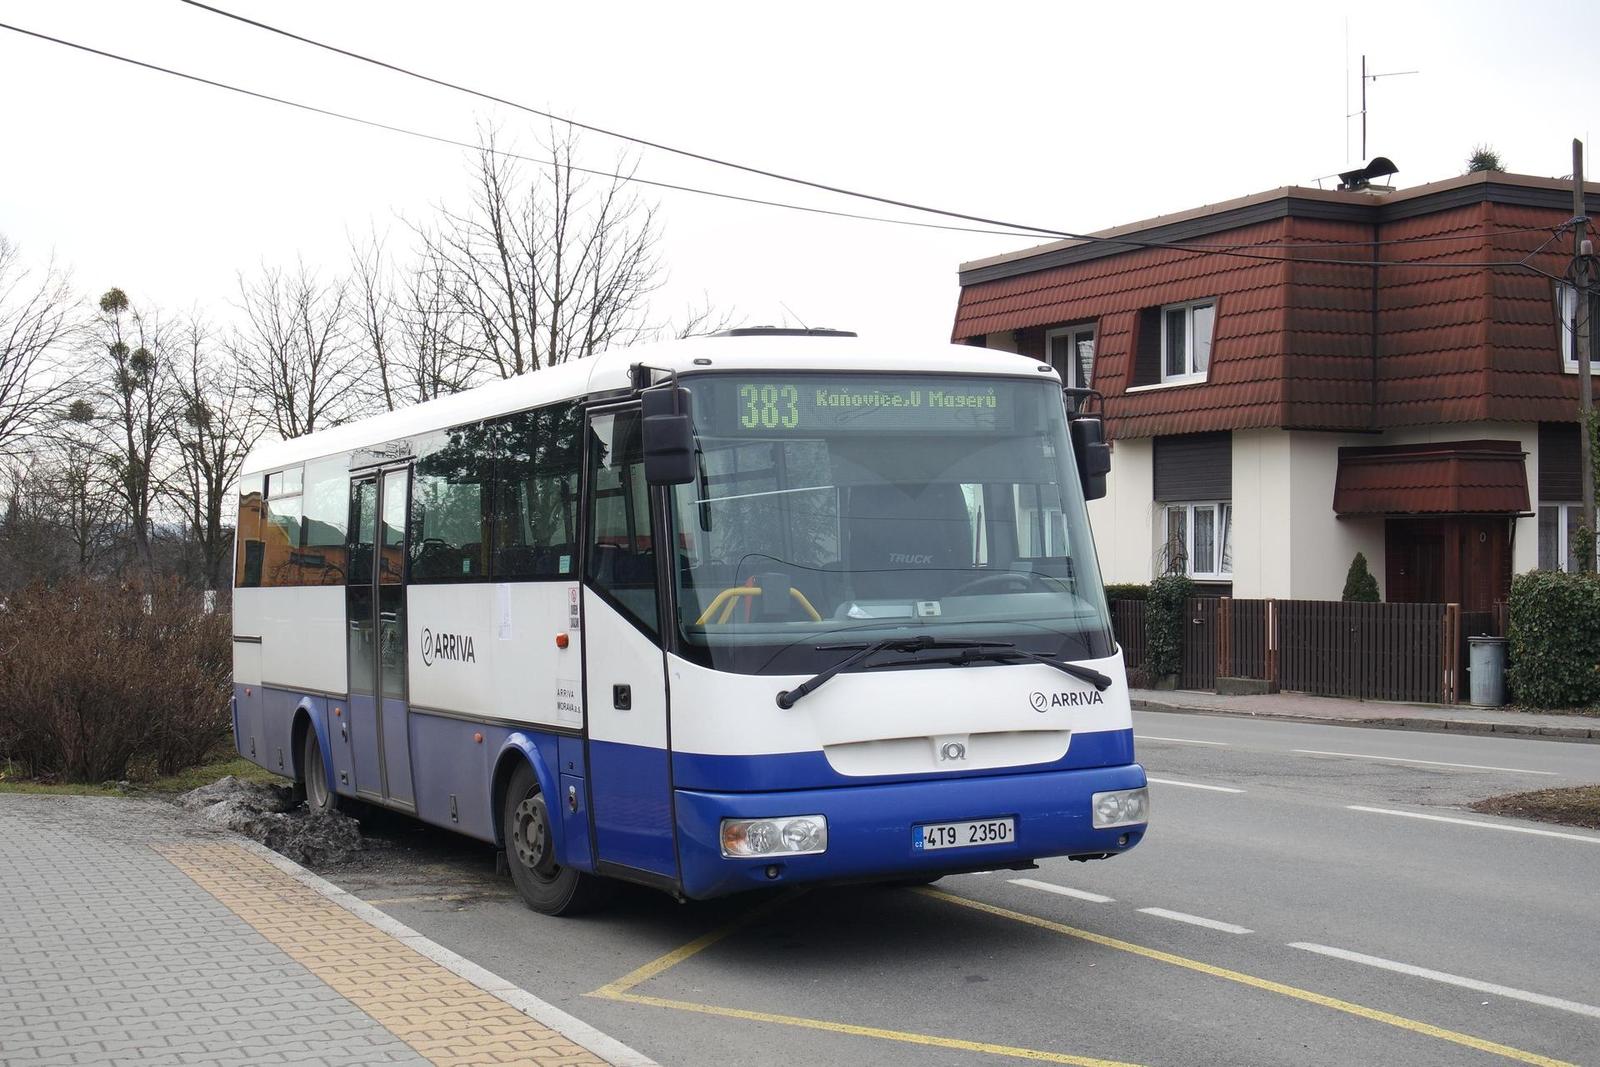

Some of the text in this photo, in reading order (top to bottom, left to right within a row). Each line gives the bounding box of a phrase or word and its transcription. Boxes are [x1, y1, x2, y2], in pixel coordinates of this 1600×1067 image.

[740, 384, 798, 428] 383
[889, 553, 933, 564] TRUCK
[434, 633, 475, 663] ARRIVA
[557, 688, 574, 698] ARRIVA
[1051, 690, 1103, 707] ARRIVA
[927, 822, 1007, 846] 4T9 2350
